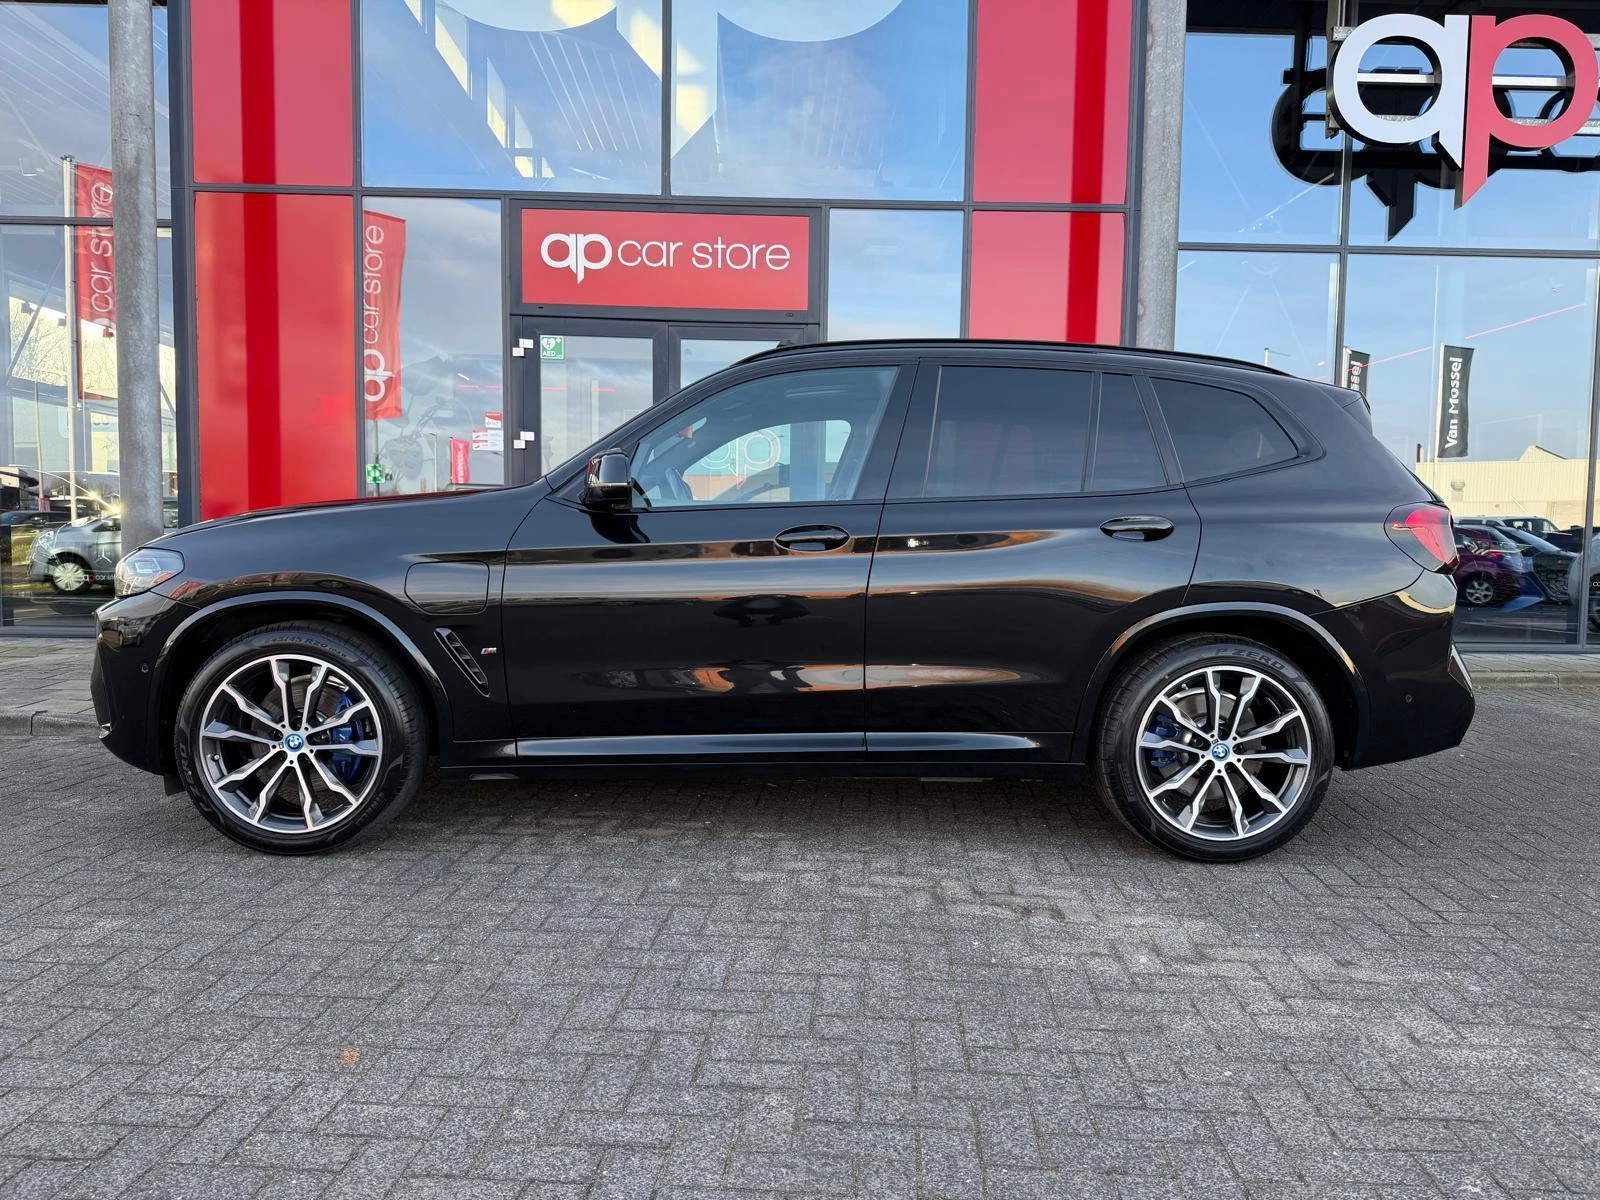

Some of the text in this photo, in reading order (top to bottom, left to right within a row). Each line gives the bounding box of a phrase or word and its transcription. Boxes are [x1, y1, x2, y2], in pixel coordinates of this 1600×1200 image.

[1333, 13, 1599, 208] ap
[90, 262, 113, 313] car
[364, 225, 385, 295] store
[540, 233, 791, 284] ap car store
[1445, 356, 1463, 449] Van Mossel
[1231, 648, 1286, 671] ZERO
